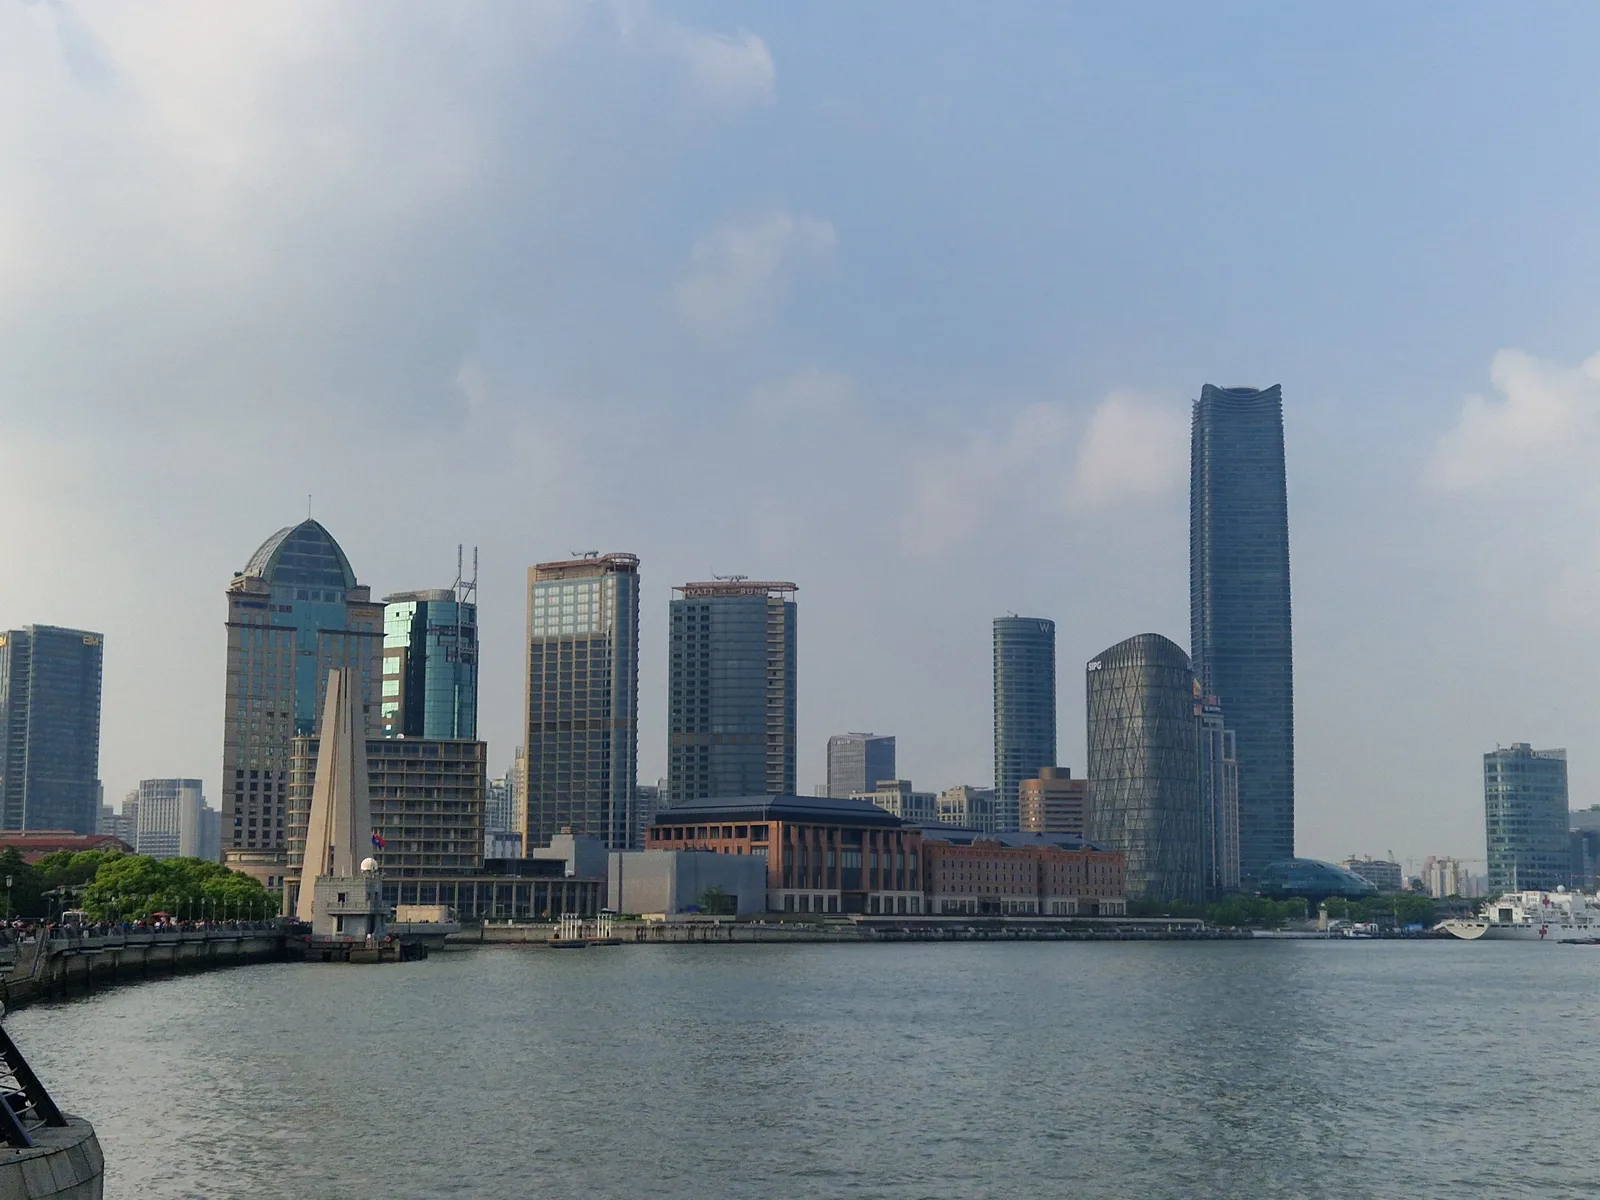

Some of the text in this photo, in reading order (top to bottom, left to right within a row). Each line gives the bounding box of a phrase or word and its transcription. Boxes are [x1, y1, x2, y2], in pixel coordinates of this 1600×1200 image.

[684, 587, 714, 595] HYATT
[740, 587, 768, 595] BUND
[1039, 621, 1049, 632] W
[1088, 661, 1101, 671] SIPG
